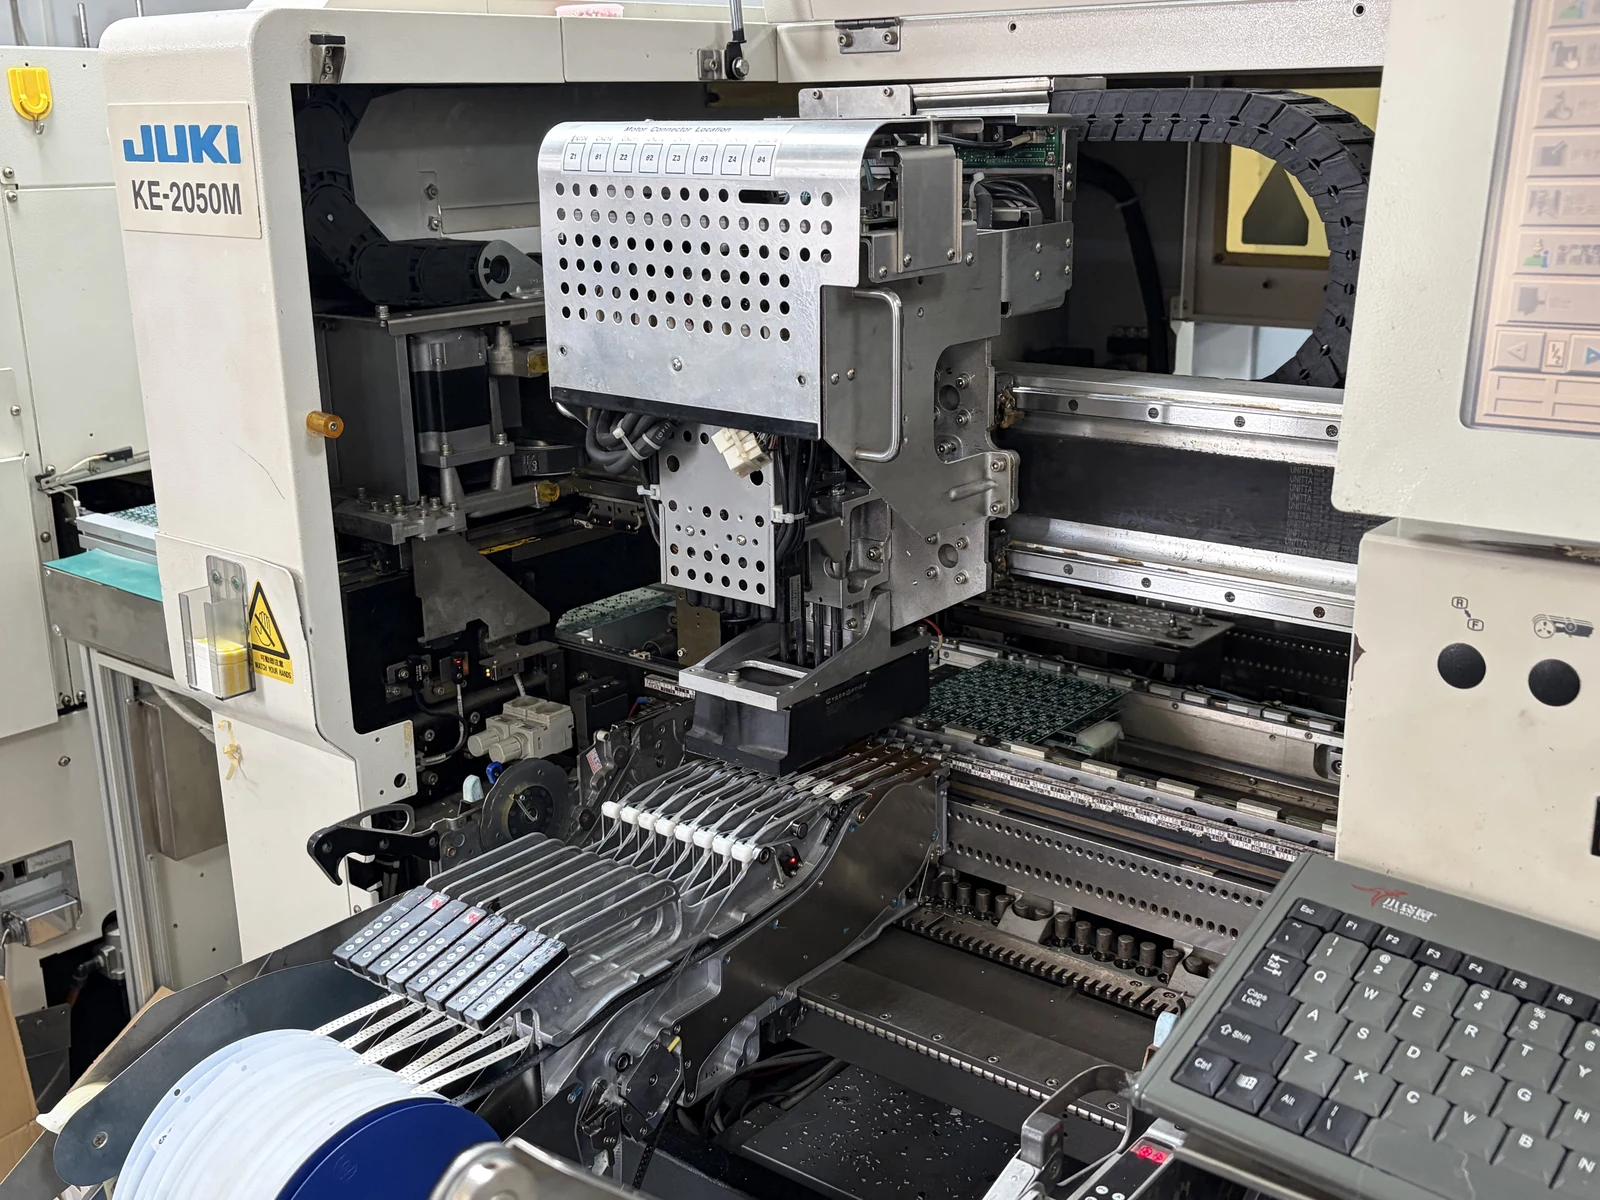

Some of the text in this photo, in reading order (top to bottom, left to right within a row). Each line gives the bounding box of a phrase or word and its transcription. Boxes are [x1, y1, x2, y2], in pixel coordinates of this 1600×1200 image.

[123, 124, 241, 164] JUKI
[672, 154, 681, 162] Z3
[131, 179, 242, 215] KE-2050M
[1290, 466, 1313, 475] UNITTA
[1290, 476, 1312, 484] UNITTA
[1290, 484, 1312, 493] UNITTA
[1289, 492, 1312, 502] UNITTA
[1456, 598, 1464, 607] R
[1472, 620, 1479, 629] F
[1300, 904, 1316, 916] Esc
[1345, 920, 1358, 930] F1
[1385, 934, 1400, 944] F2
[1326, 948, 1333, 956] 1
[1426, 948, 1441, 959] F3
[1266, 958, 1281, 970] Tab
[1372, 964, 1384, 974] 2
[1468, 962, 1484, 974] F4
[1313, 970, 1327, 984] Q
[1422, 982, 1433, 992] 3
[1512, 978, 1528, 990] F5
[1246, 988, 1268, 1002] Caps
[1363, 986, 1380, 1000] W
[1556, 993, 1574, 1006] F6
[1241, 994, 1262, 1008] Lock
[1473, 1002, 1484, 1011] 4
[1306, 1008, 1319, 1021] A
[1412, 1005, 1426, 1018] E
[1464, 1024, 1478, 1038] R
[1528, 1020, 1540, 1030] 5
[1231, 1029, 1252, 1044] Shift
[1356, 1027, 1370, 1040] S
[1406, 1045, 1420, 1059] D
[1521, 1043, 1534, 1056] T
[1584, 1040, 1596, 1052] 6
[1304, 1050, 1318, 1062] Z
[1194, 1057, 1213, 1072] Ctrl
[1460, 1065, 1475, 1077] F
[1578, 1064, 1592, 1078] Y
[1353, 1069, 1369, 1084] X
[1280, 1093, 1296, 1106] Alt
[1406, 1090, 1420, 1104] C
[1516, 1088, 1532, 1102] G
[1463, 1110, 1477, 1125] V
[1574, 1108, 1590, 1124] H
[1518, 1133, 1534, 1148] B
[1578, 1156, 1596, 1173] N
